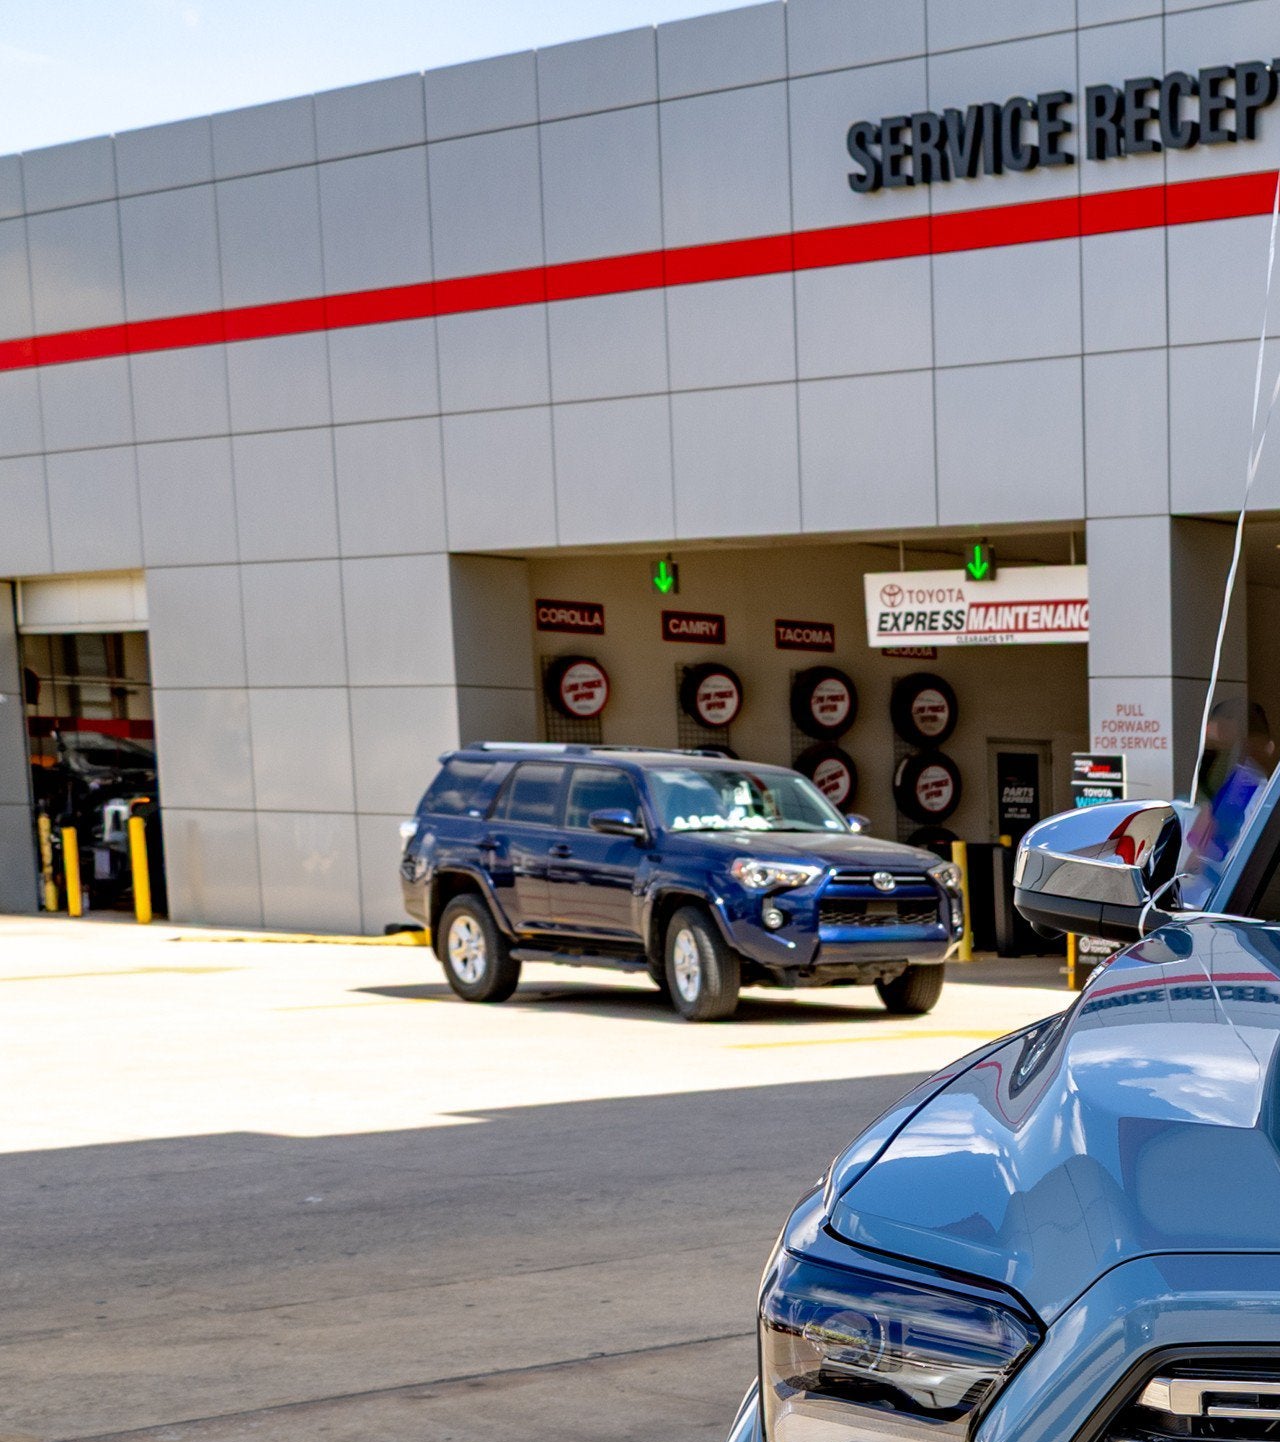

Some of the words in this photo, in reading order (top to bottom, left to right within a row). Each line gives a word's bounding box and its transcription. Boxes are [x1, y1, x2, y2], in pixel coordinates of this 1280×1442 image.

[847, 90, 1075, 193] SERVICE
[908, 589, 965, 604] TOYOTA
[539, 608, 603, 626] COROLLA
[878, 610, 965, 632] EXPRESS
[669, 619, 718, 636] CAMRY
[777, 627, 832, 644] TACOMA
[956, 635, 997, 644] CLEARANCE
[1116, 704, 1144, 717] PULL
[1102, 720, 1159, 733] FORWARD
[1095, 737, 1117, 749] FOR
[1120, 737, 1168, 749] SERVICE
[1003, 787, 1034, 797] PARTS
[1083, 788, 1113, 797] TOYOTA
